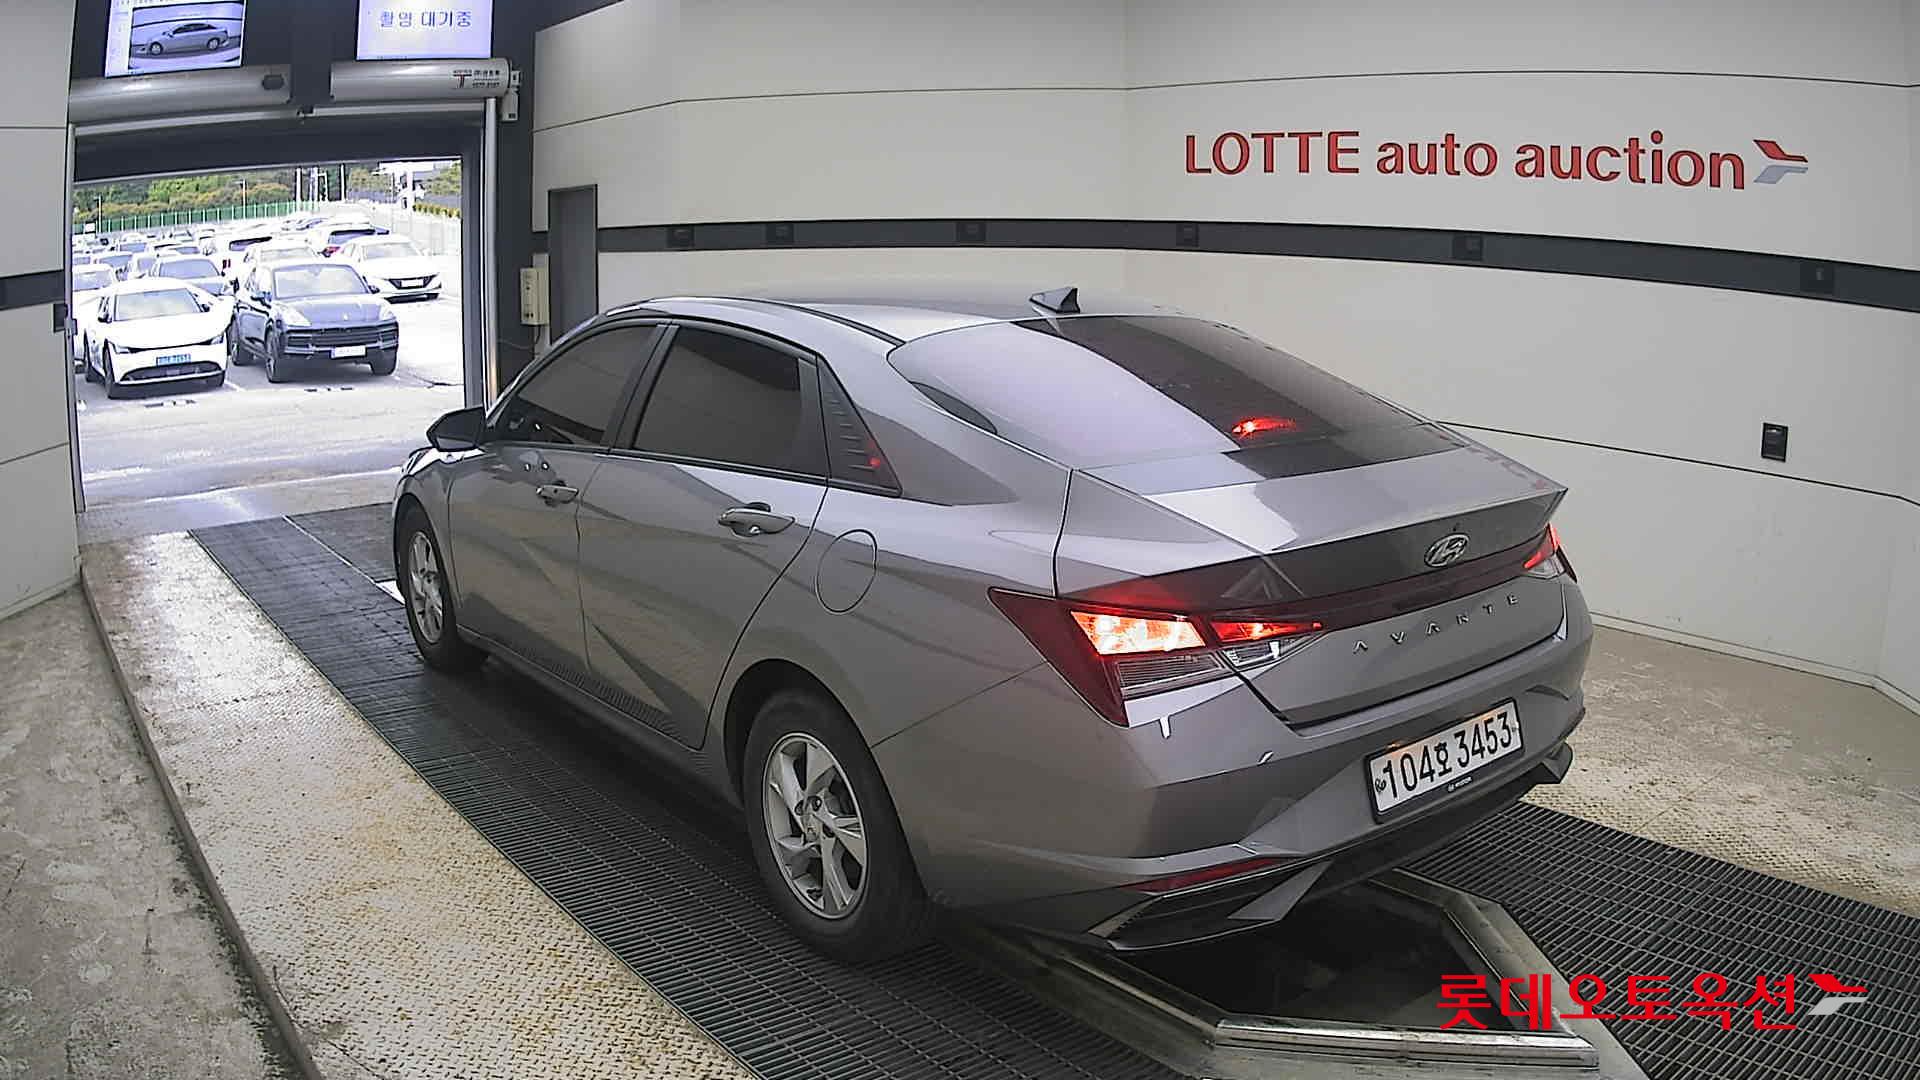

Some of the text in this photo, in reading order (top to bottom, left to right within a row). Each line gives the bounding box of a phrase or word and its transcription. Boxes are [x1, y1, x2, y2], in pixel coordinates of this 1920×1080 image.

[421, 10, 472, 28] 대기중
[1185, 131, 1745, 190] LOTTE auto auction
[1353, 594, 1519, 654] AVANTE
[1383, 711, 1513, 798] 104호 3453
